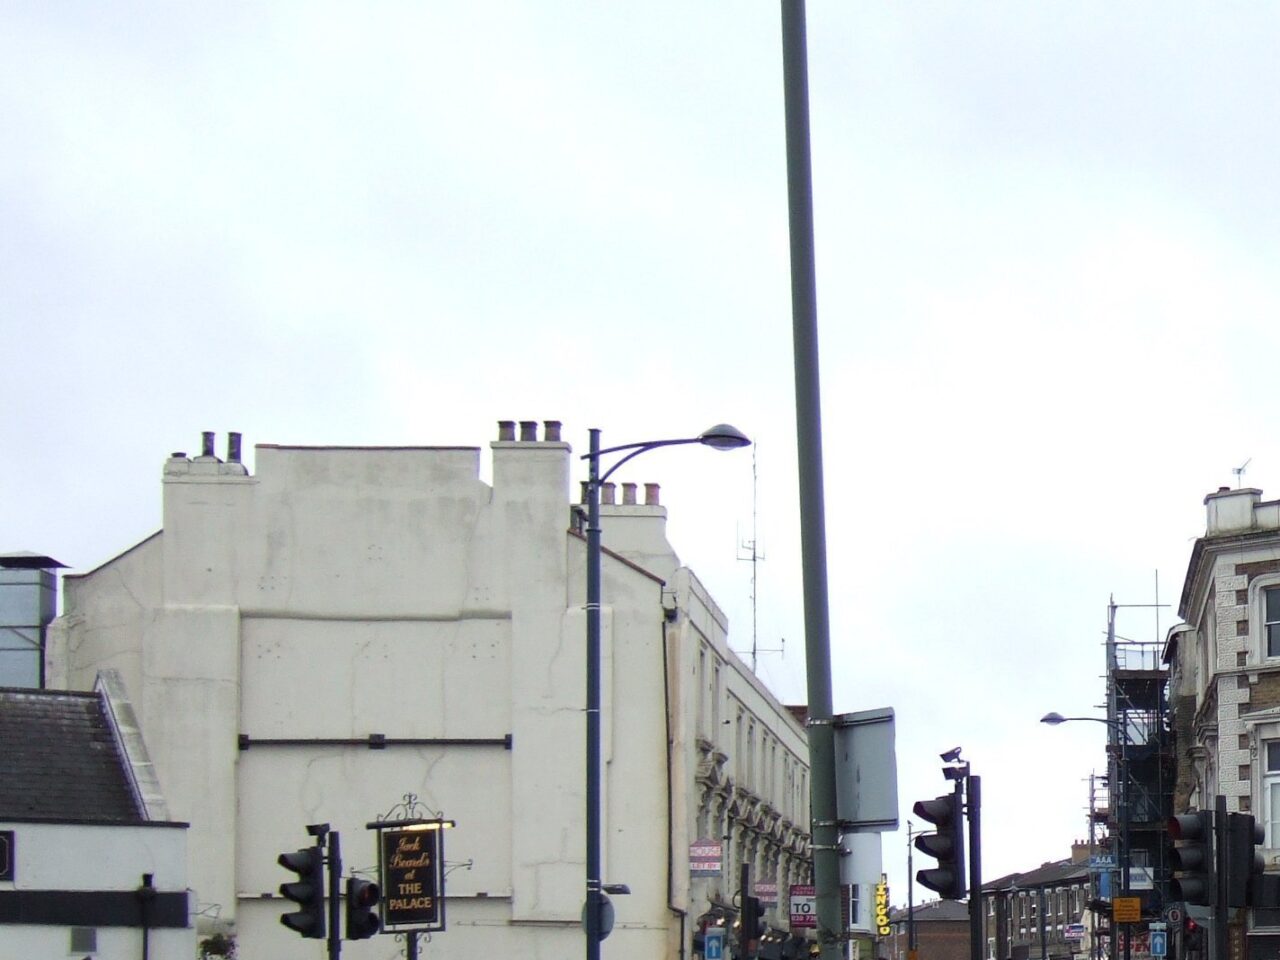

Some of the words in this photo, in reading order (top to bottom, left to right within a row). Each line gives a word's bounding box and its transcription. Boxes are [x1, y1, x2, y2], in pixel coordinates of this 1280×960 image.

[1095, 856, 1112, 864] AAA
[398, 882, 422, 895] THE
[389, 897, 432, 910] PALACE
[793, 903, 811, 914] TO
